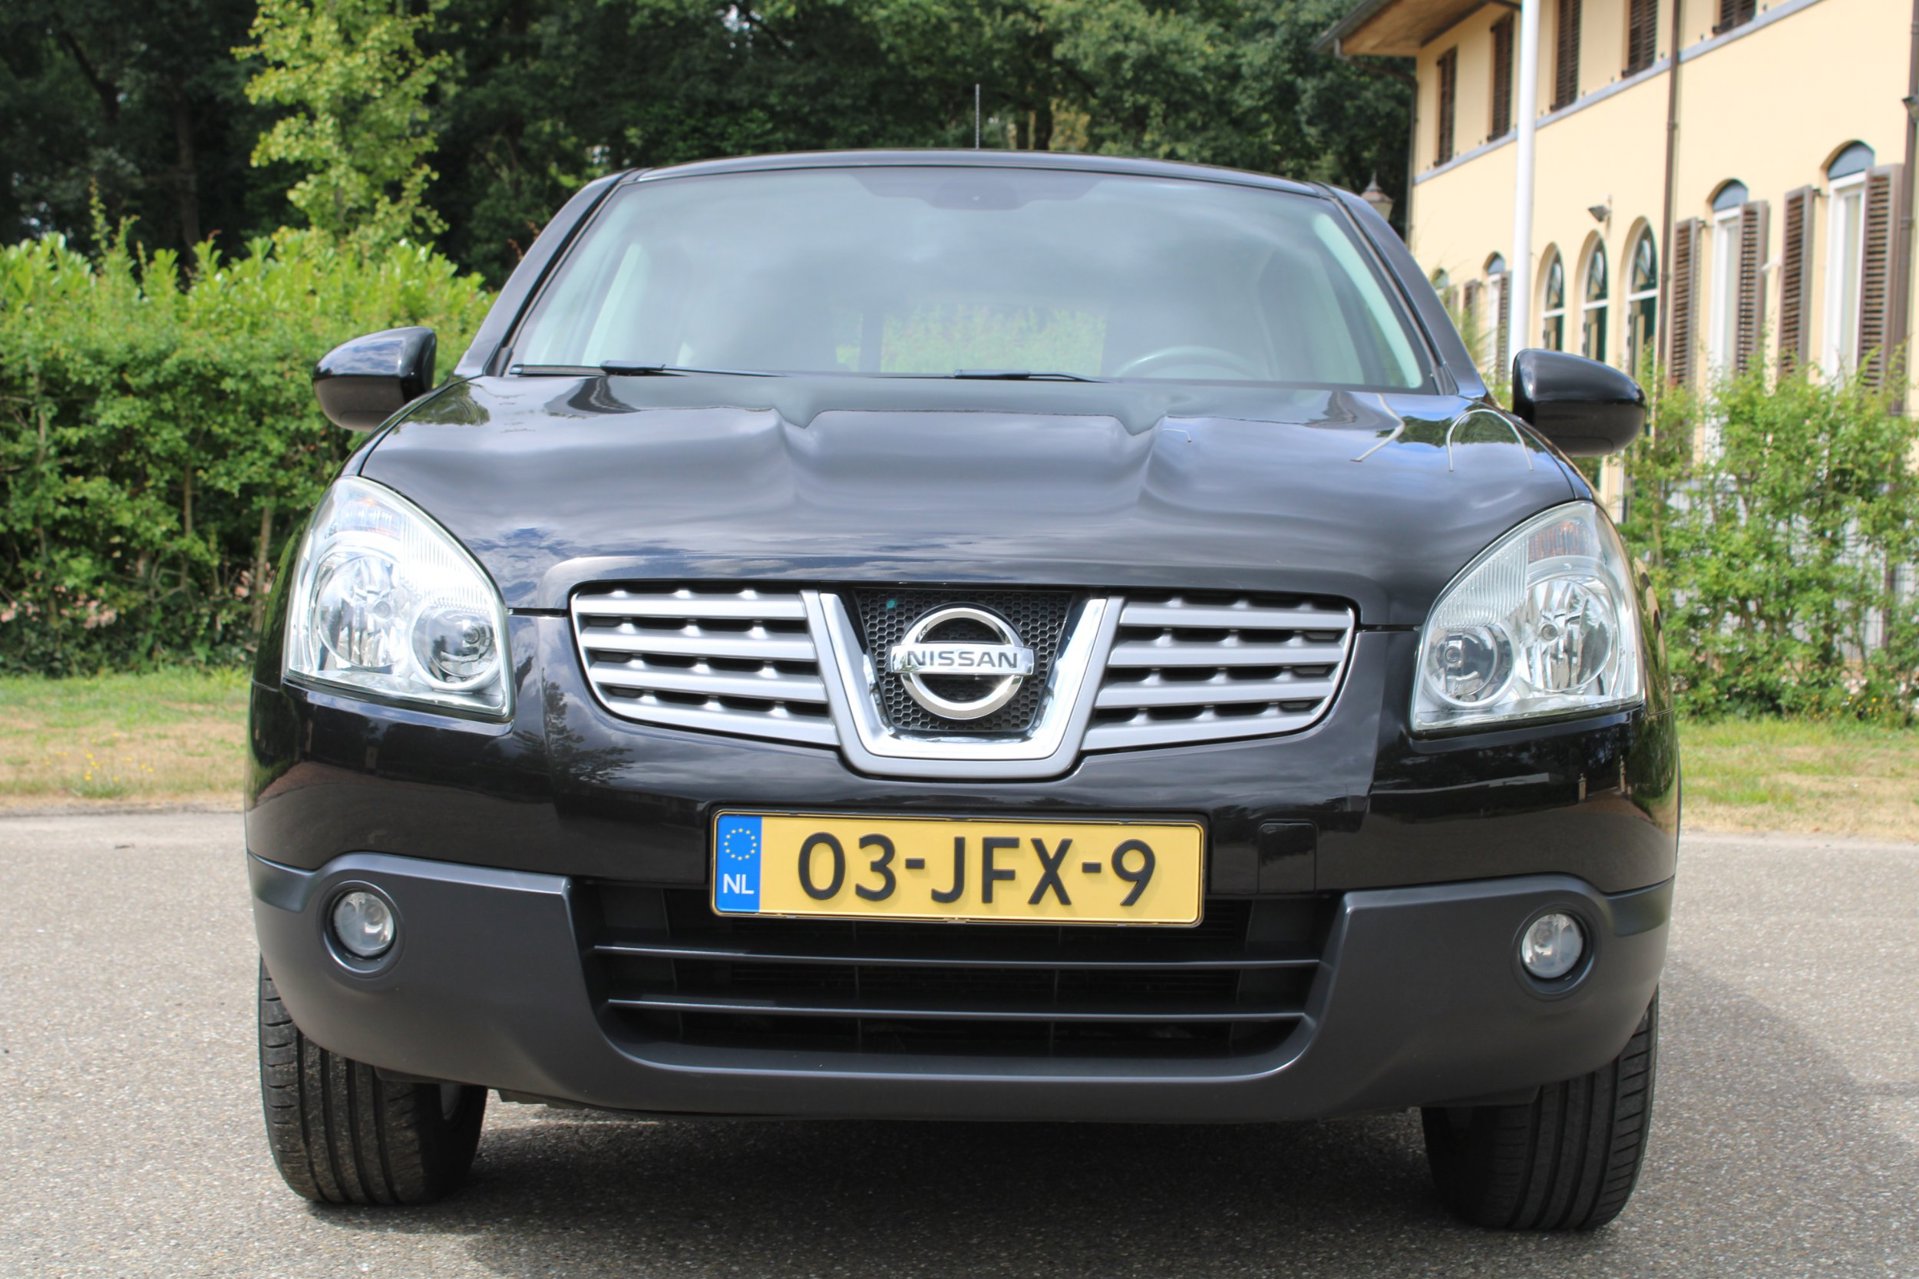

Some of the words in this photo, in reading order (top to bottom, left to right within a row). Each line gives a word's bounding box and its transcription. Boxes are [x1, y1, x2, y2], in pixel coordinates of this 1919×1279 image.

[907, 650, 1018, 669] NISSAN
[797, 831, 1156, 907] 03-JFX-9
[722, 873, 755, 896] NL
